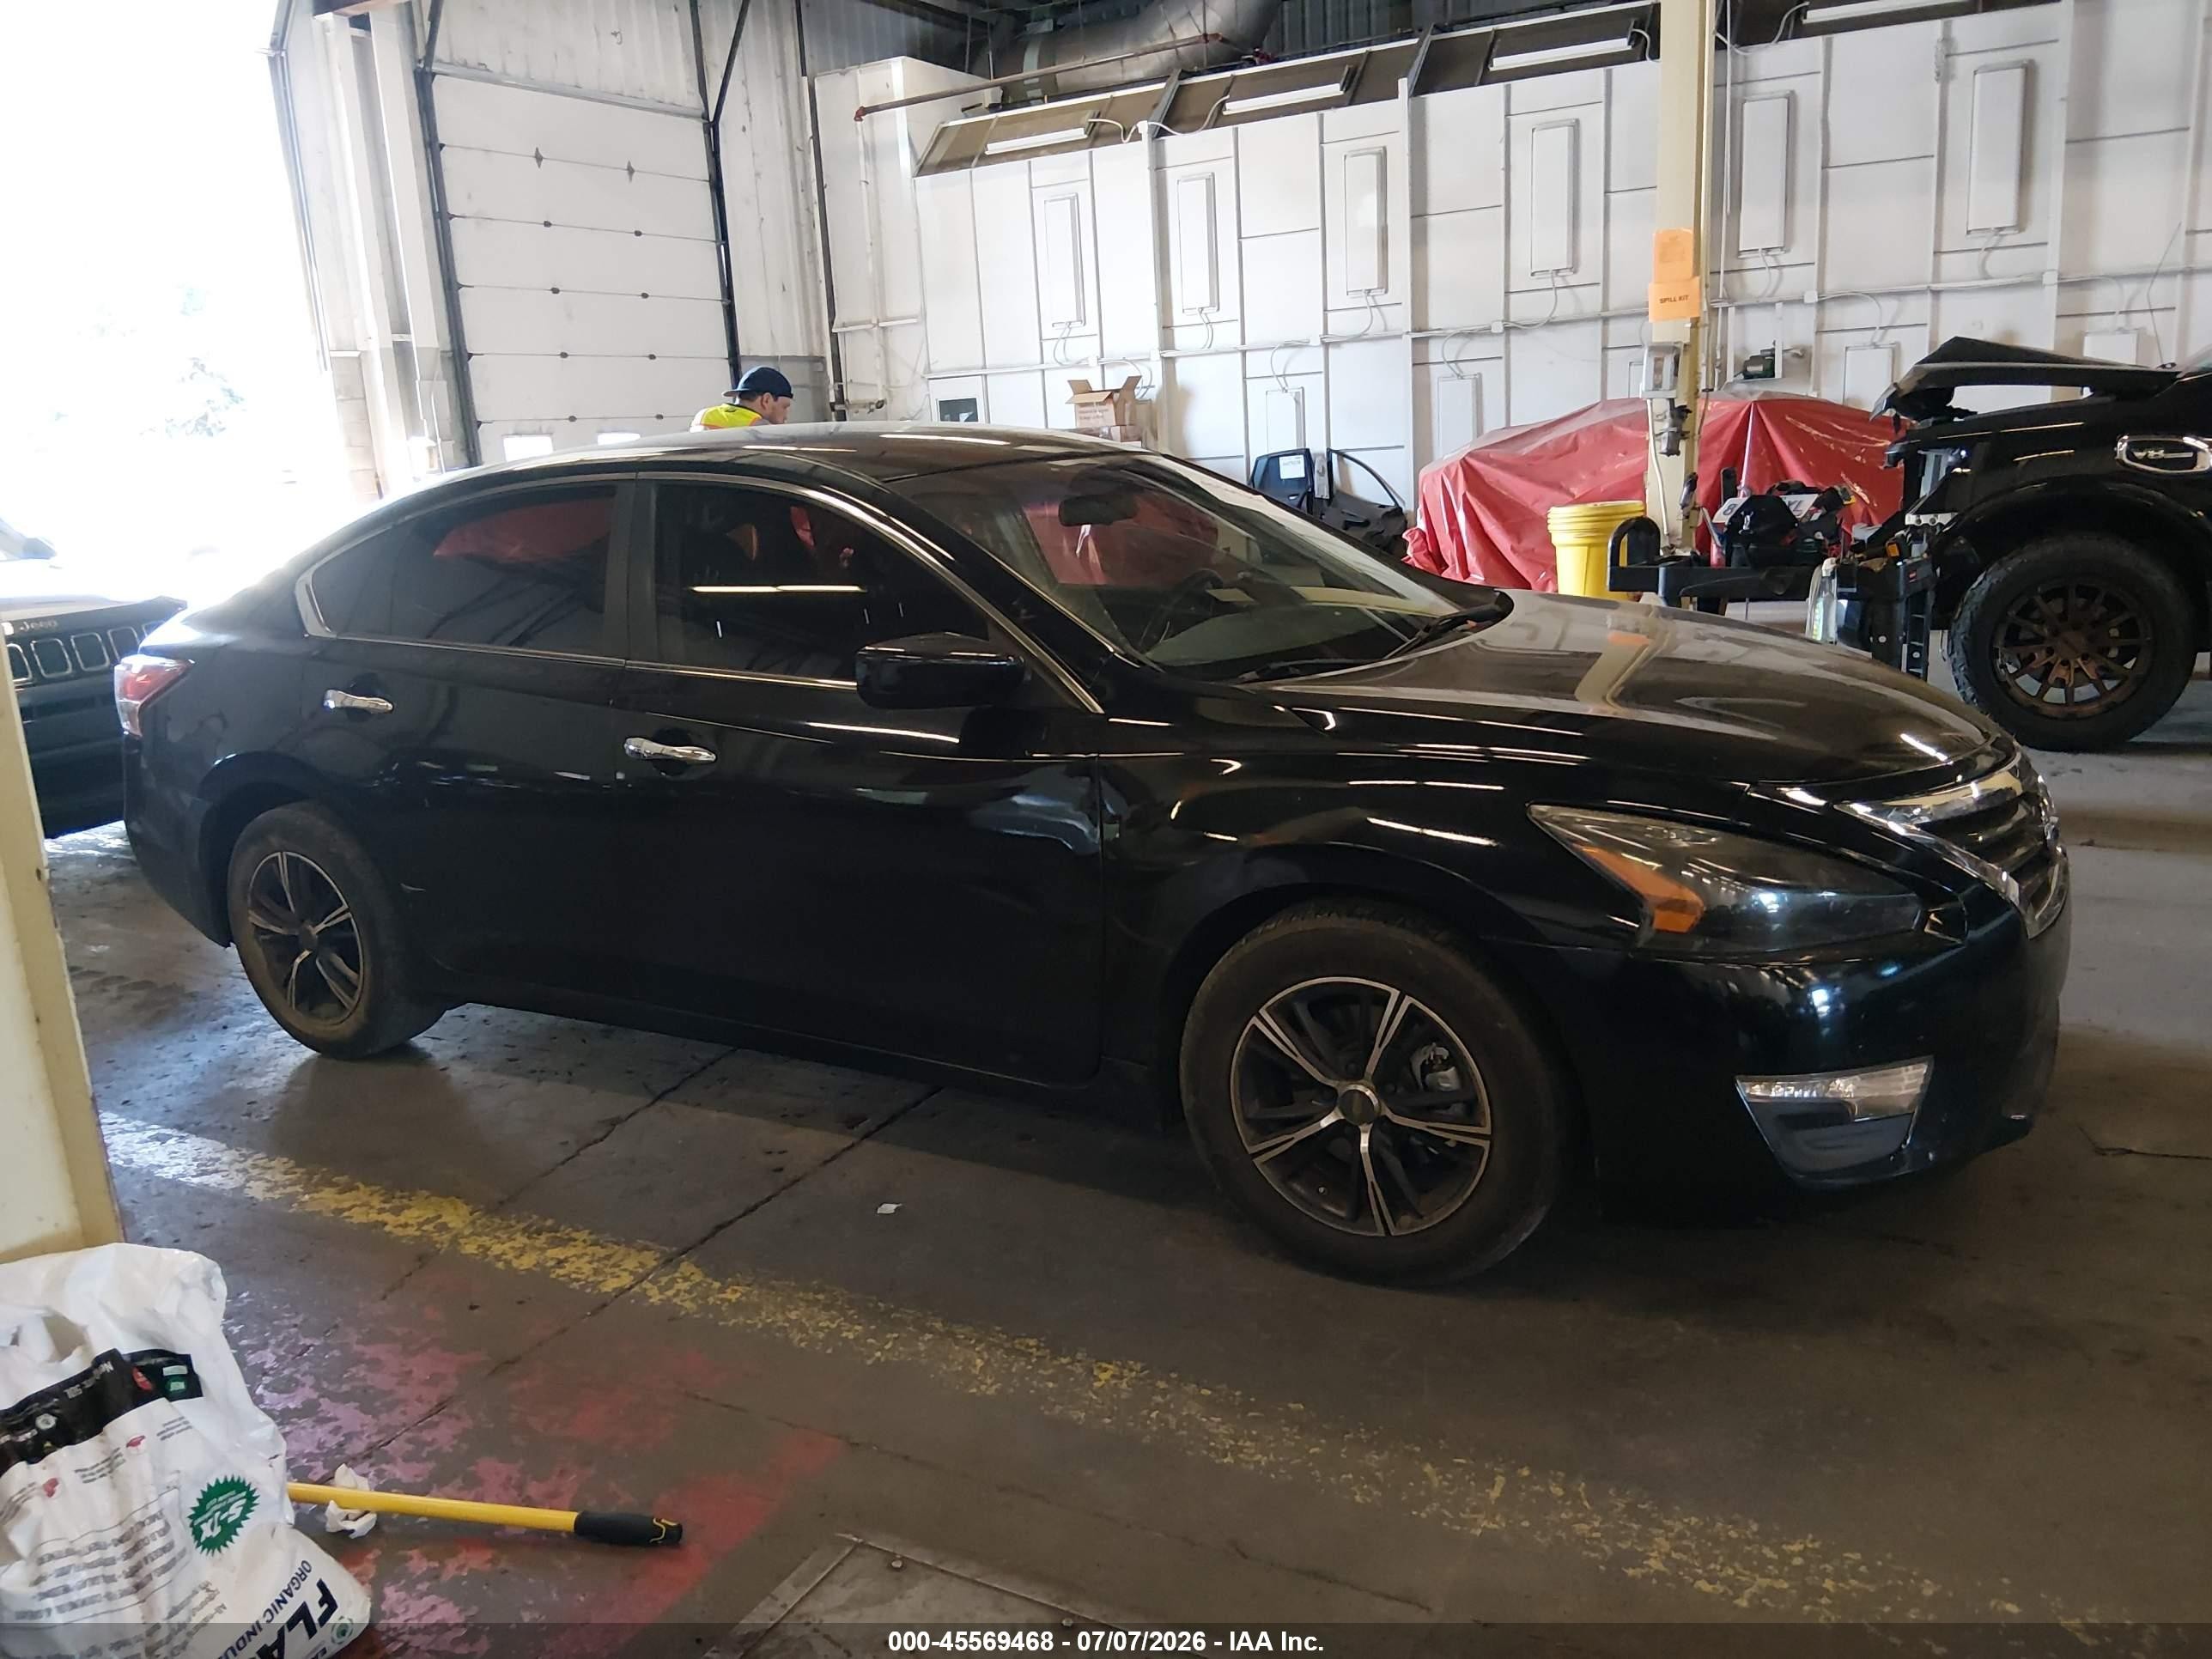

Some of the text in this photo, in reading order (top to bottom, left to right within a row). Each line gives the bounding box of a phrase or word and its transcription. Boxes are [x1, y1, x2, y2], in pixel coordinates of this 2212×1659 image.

[20, 620, 58, 631] Jeep
[263, 1559, 313, 1624] ORGANIC
[217, 1620, 263, 1658] INDU
[249, 1578, 338, 1658] FLA
